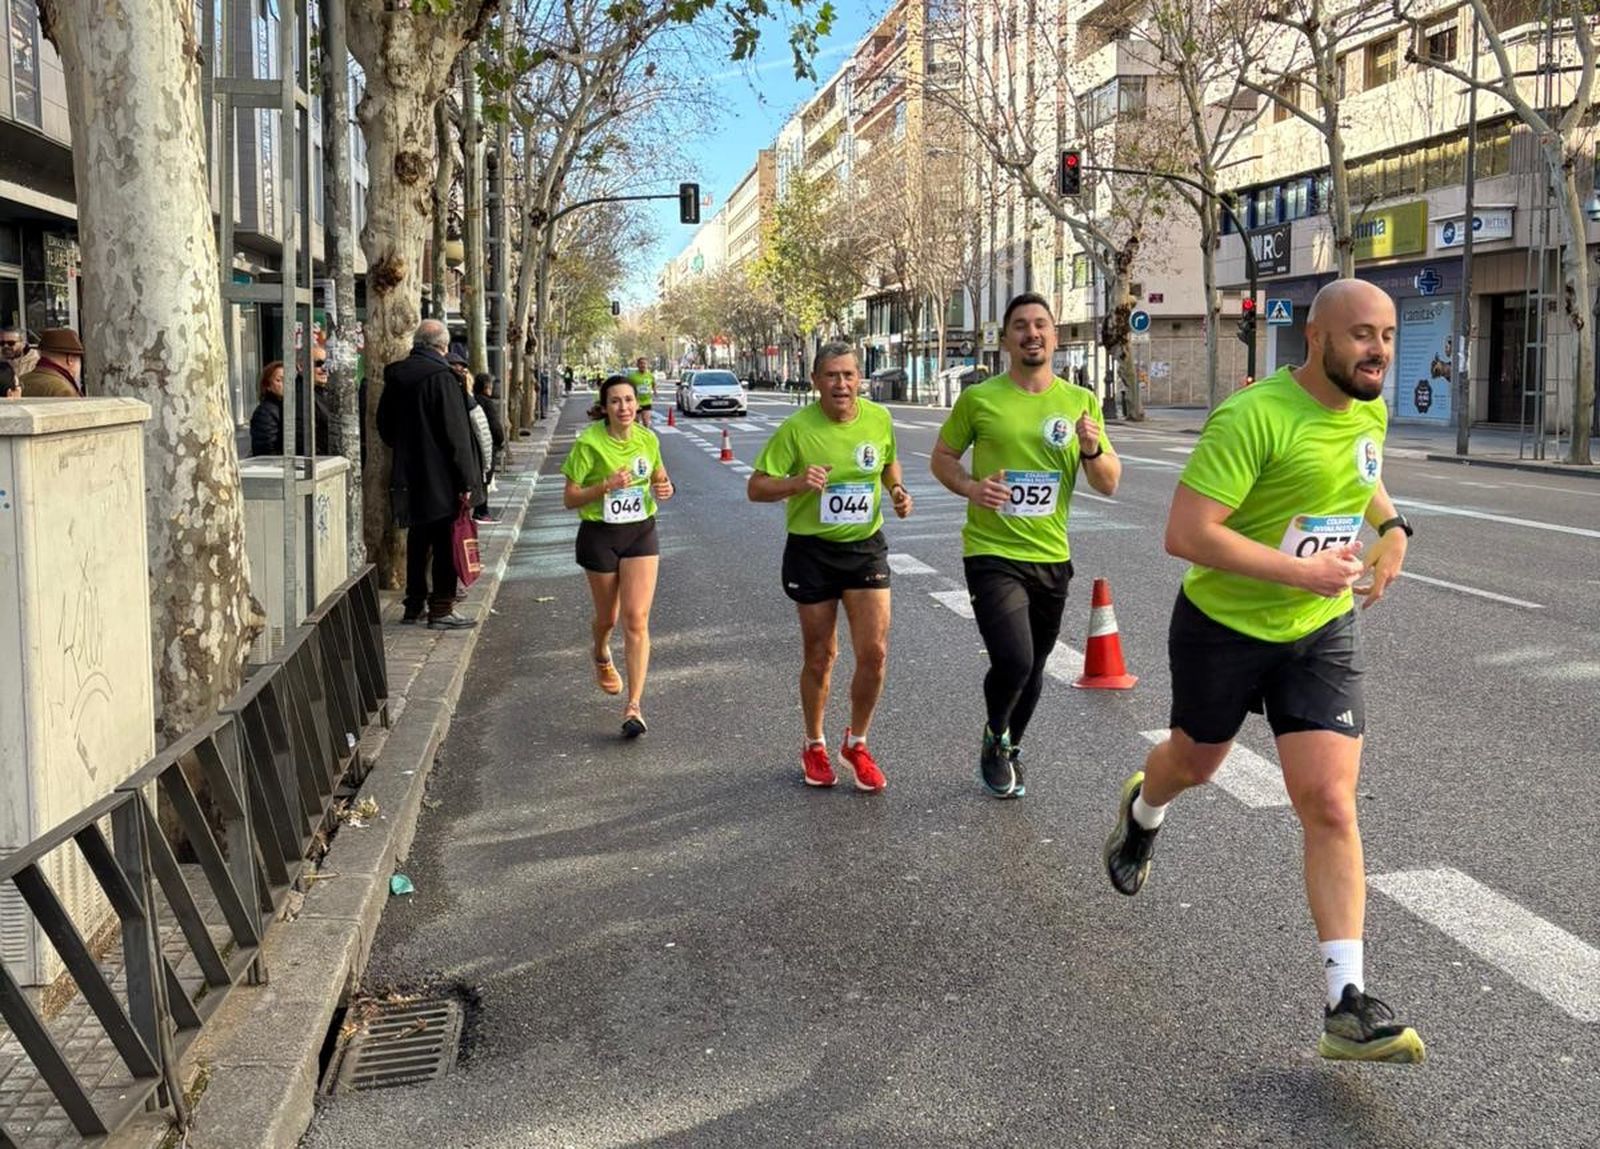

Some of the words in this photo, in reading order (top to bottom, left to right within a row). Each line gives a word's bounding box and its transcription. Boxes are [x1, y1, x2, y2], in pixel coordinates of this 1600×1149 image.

[829, 495, 868, 514] 044
[1010, 485, 1052, 505] 052
[611, 497, 641, 515] 046
